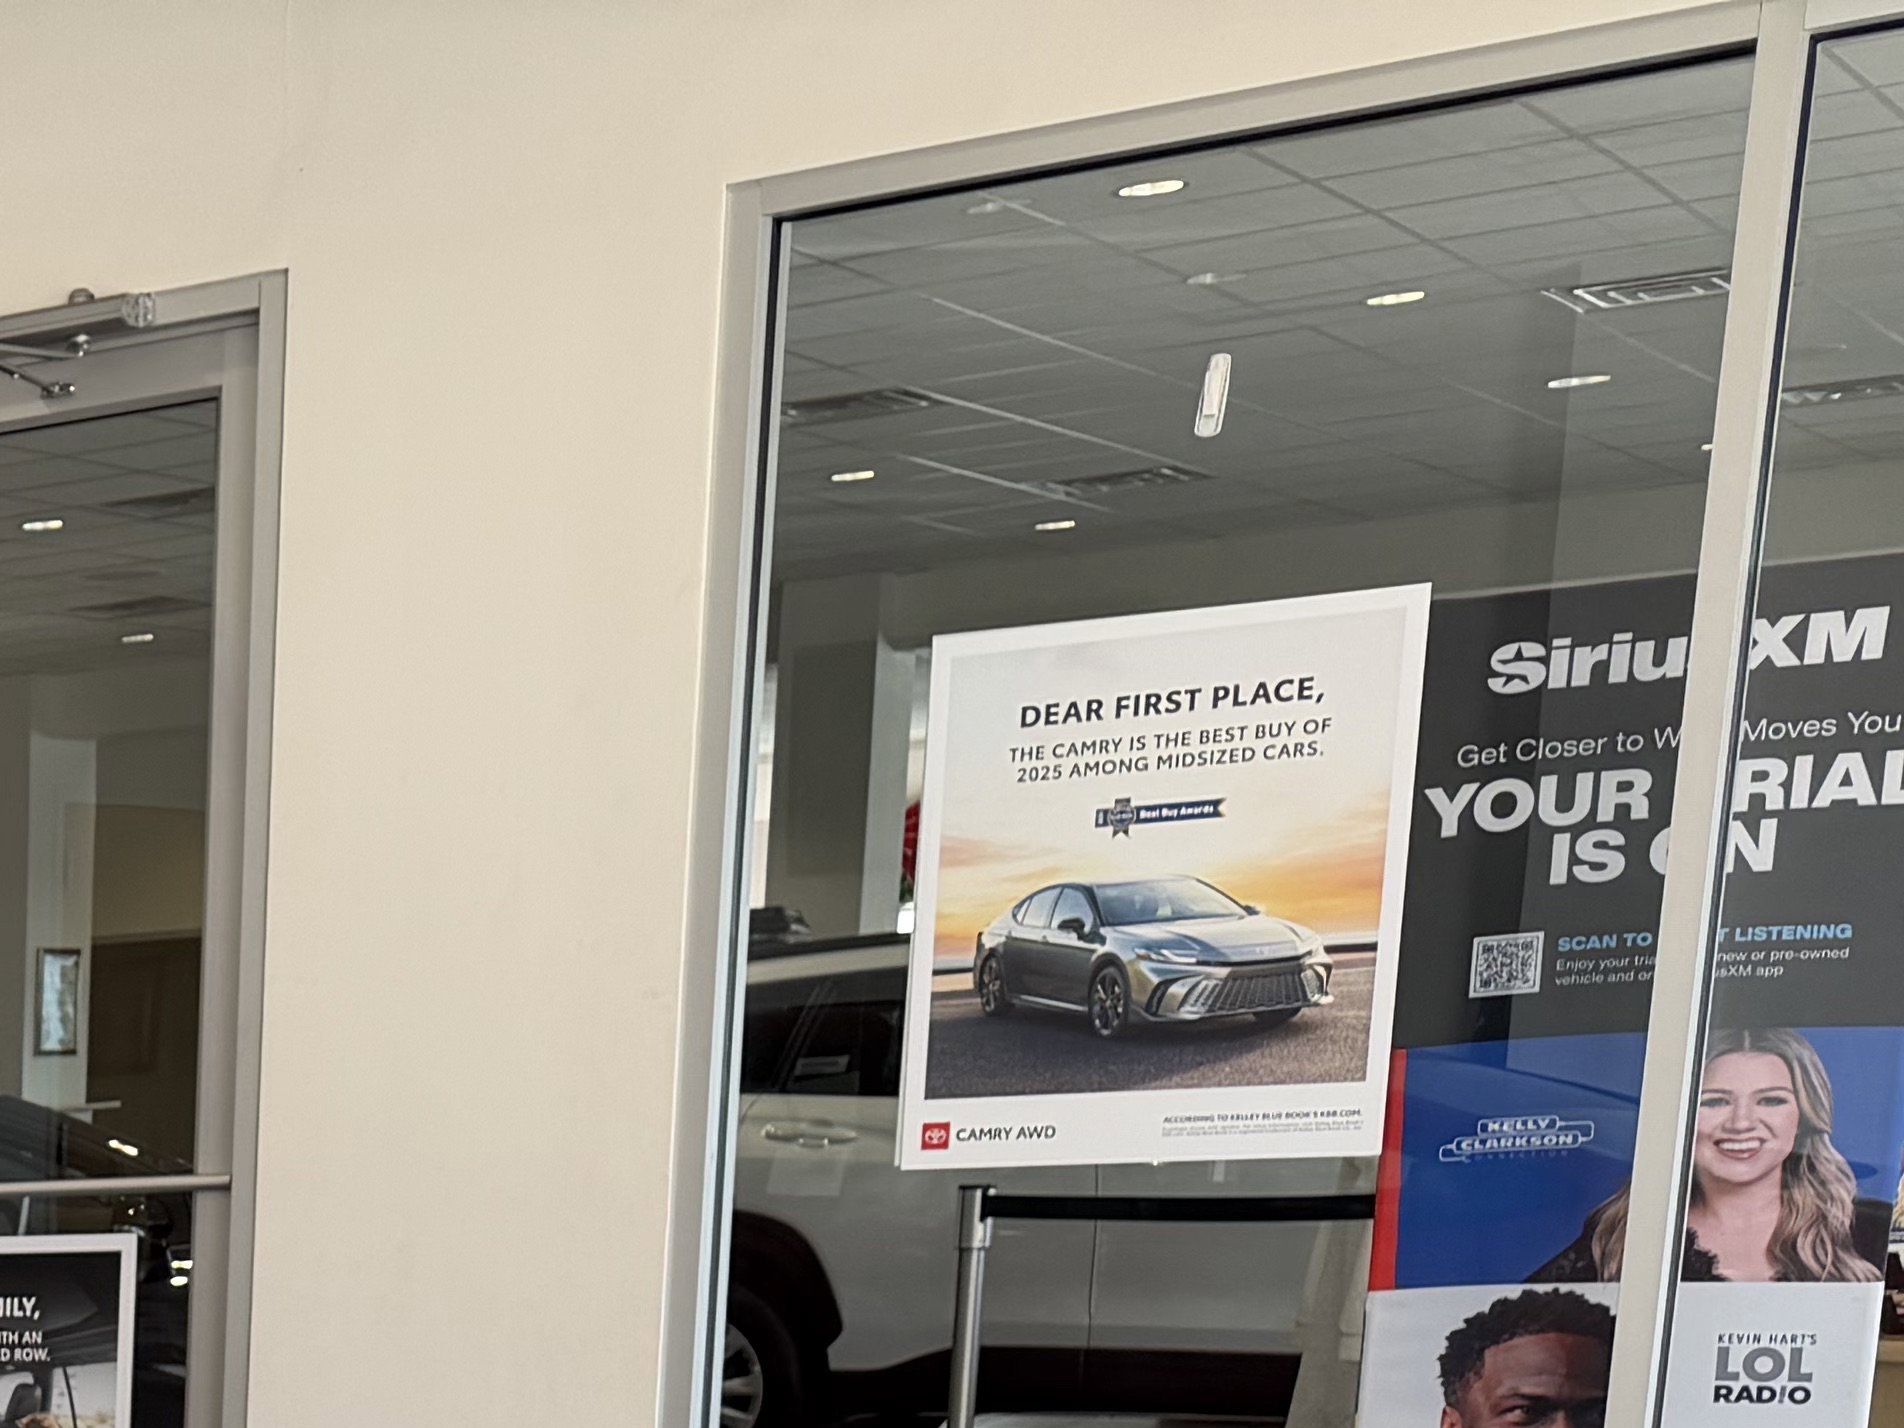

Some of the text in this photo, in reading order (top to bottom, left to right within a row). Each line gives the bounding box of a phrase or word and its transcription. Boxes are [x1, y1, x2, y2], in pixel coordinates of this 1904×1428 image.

[1020, 676, 1325, 728] DEAR FIRST PLACE,
[1742, 710, 1902, 743] Moves You
[1009, 717, 1332, 763] THE CAMRY IS THE BEST BUY OF
[1457, 744, 1508, 768] Get
[1516, 732, 1609, 762] Closer
[1616, 731, 1644, 753] to
[1016, 741, 1324, 784] 2025 AMONG MIDSIZED CARS.
[1730, 750, 1904, 814] RIAL
[1424, 768, 1653, 839] YOUR
[1549, 830, 1625, 886] IS
[1558, 932, 1653, 951] SCAN TO
[1735, 924, 1852, 942] LISTENING
[1717, 947, 1850, 964] new or pre-owned
[1556, 958, 1595, 976] Enjoy
[1598, 957, 1630, 975] your
[1756, 965, 1784, 978] app
[1555, 972, 1604, 986] vehicle
[1607, 971, 1634, 983] and
[956, 1125, 1056, 1142] CAMRY AWD
[1487, 1118, 1549, 1132] KELLY
[1461, 1135, 1573, 1150] CLARKSON
[21, 1331, 42, 1344] AN
[1718, 1333, 1817, 1346] KEVIN HART'S
[13, 1348, 50, 1362] ROW.
[1715, 1346, 1813, 1382] LOL
[1712, 1385, 1811, 1405] RADIO
